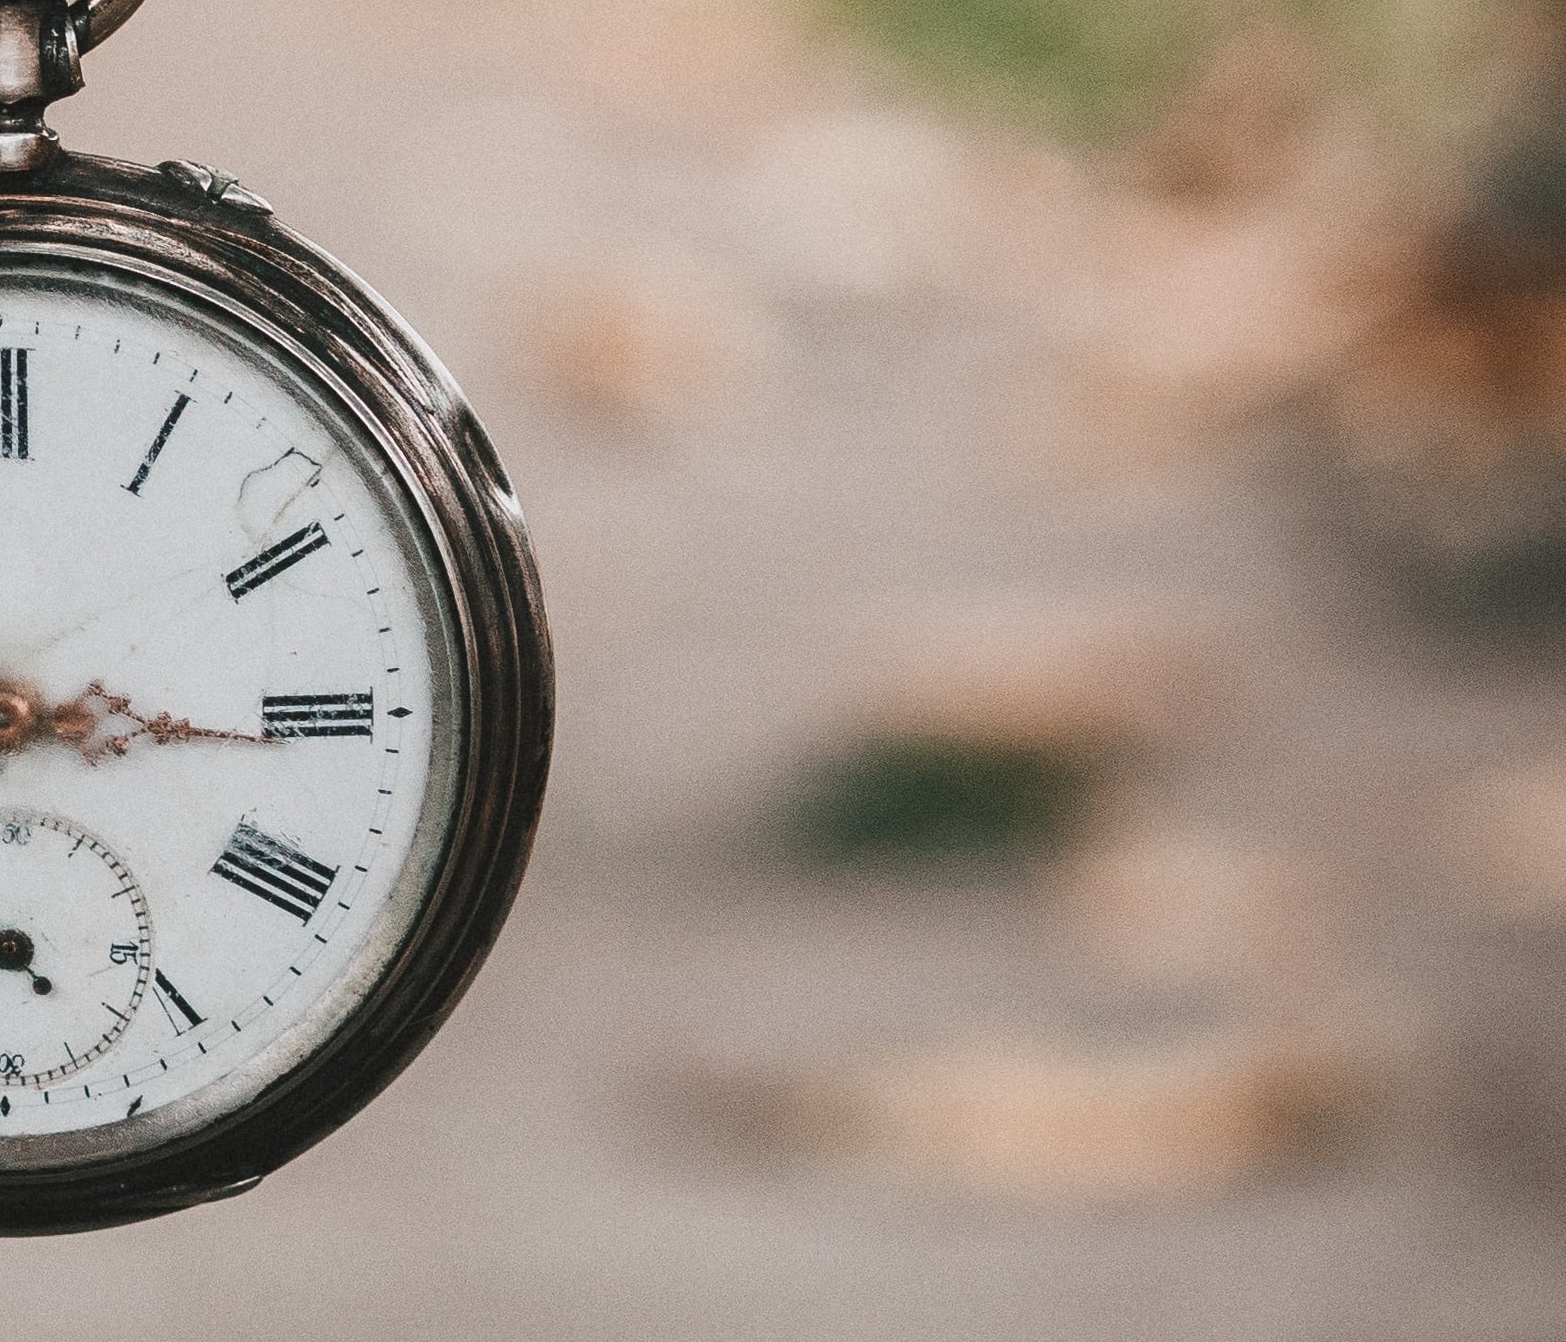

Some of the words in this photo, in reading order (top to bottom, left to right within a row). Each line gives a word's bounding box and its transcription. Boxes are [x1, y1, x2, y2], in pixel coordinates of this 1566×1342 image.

[120, 391, 197, 497] I
[223, 520, 331, 603] II
[261, 686, 374, 741] III
[109, 941, 140, 966] 15
